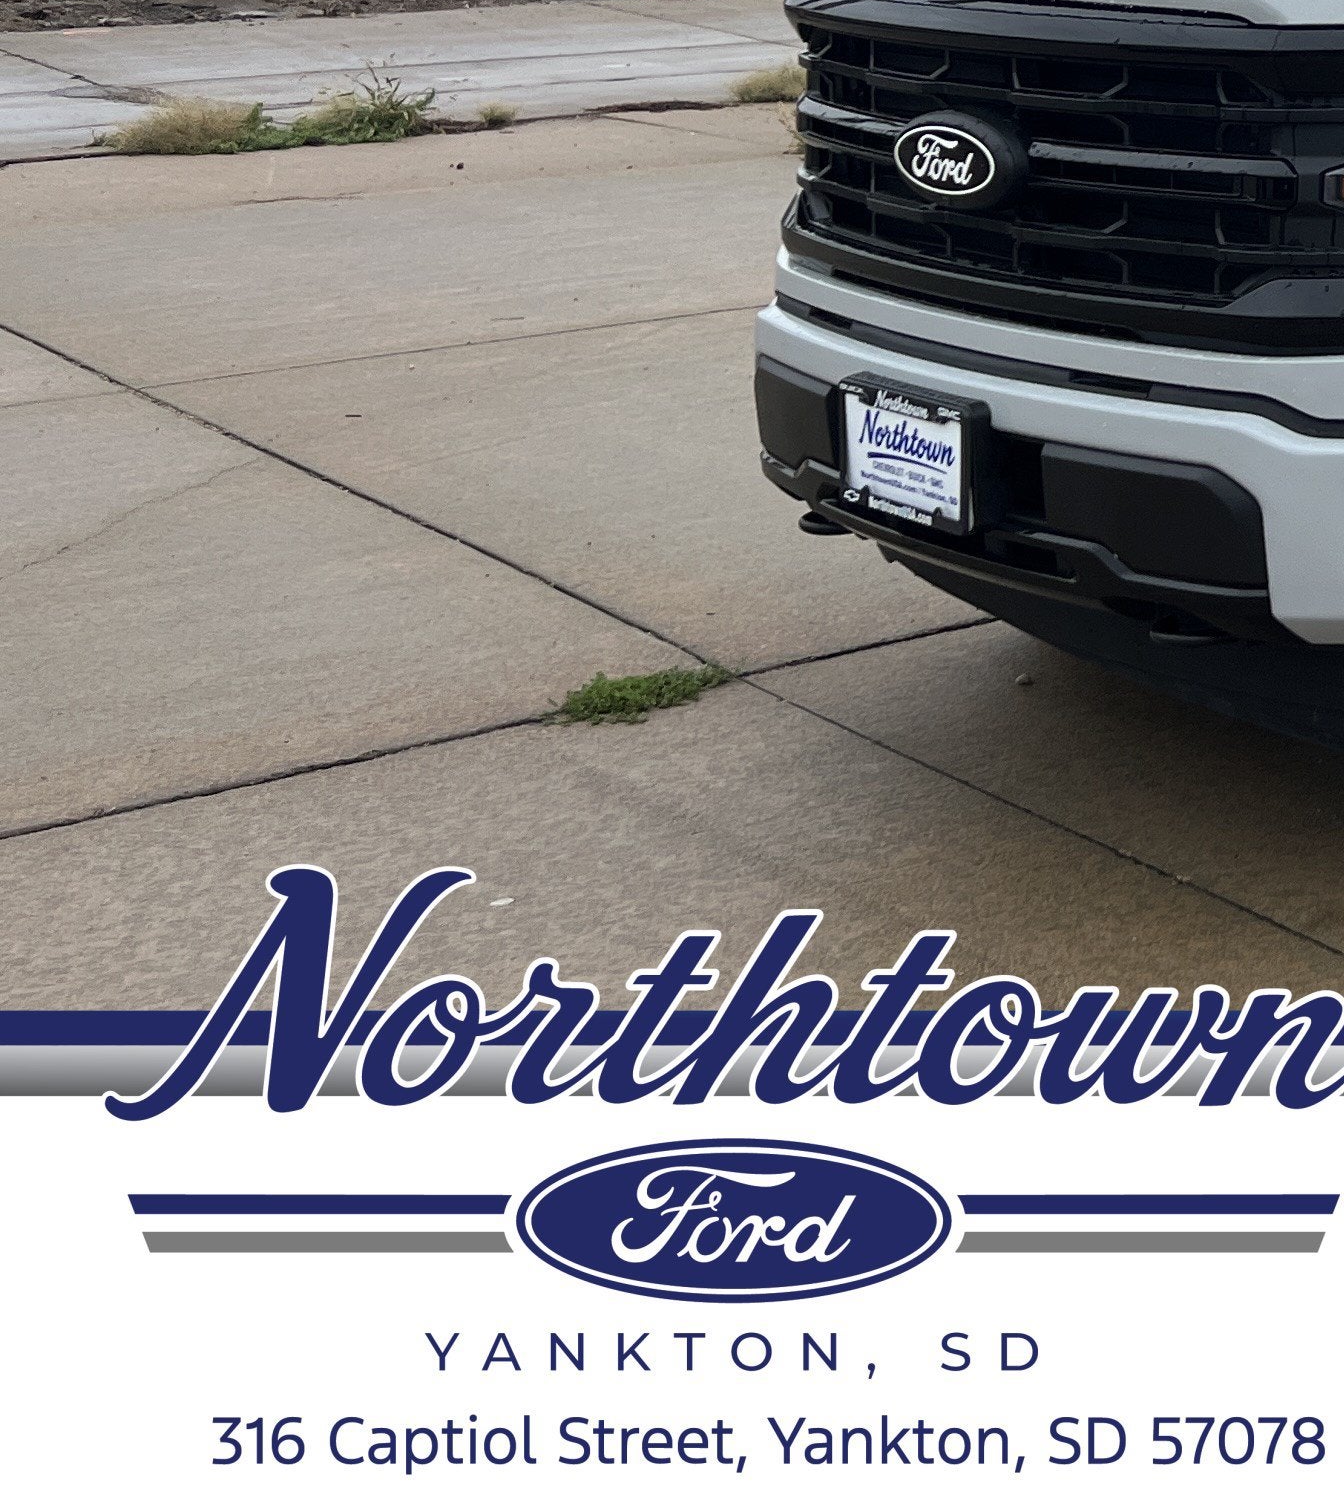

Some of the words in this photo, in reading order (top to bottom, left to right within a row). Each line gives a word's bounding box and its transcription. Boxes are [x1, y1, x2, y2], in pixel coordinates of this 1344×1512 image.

[911, 133, 975, 186] Ford
[873, 389, 930, 420] Northtown
[859, 409, 956, 467] Northtown
